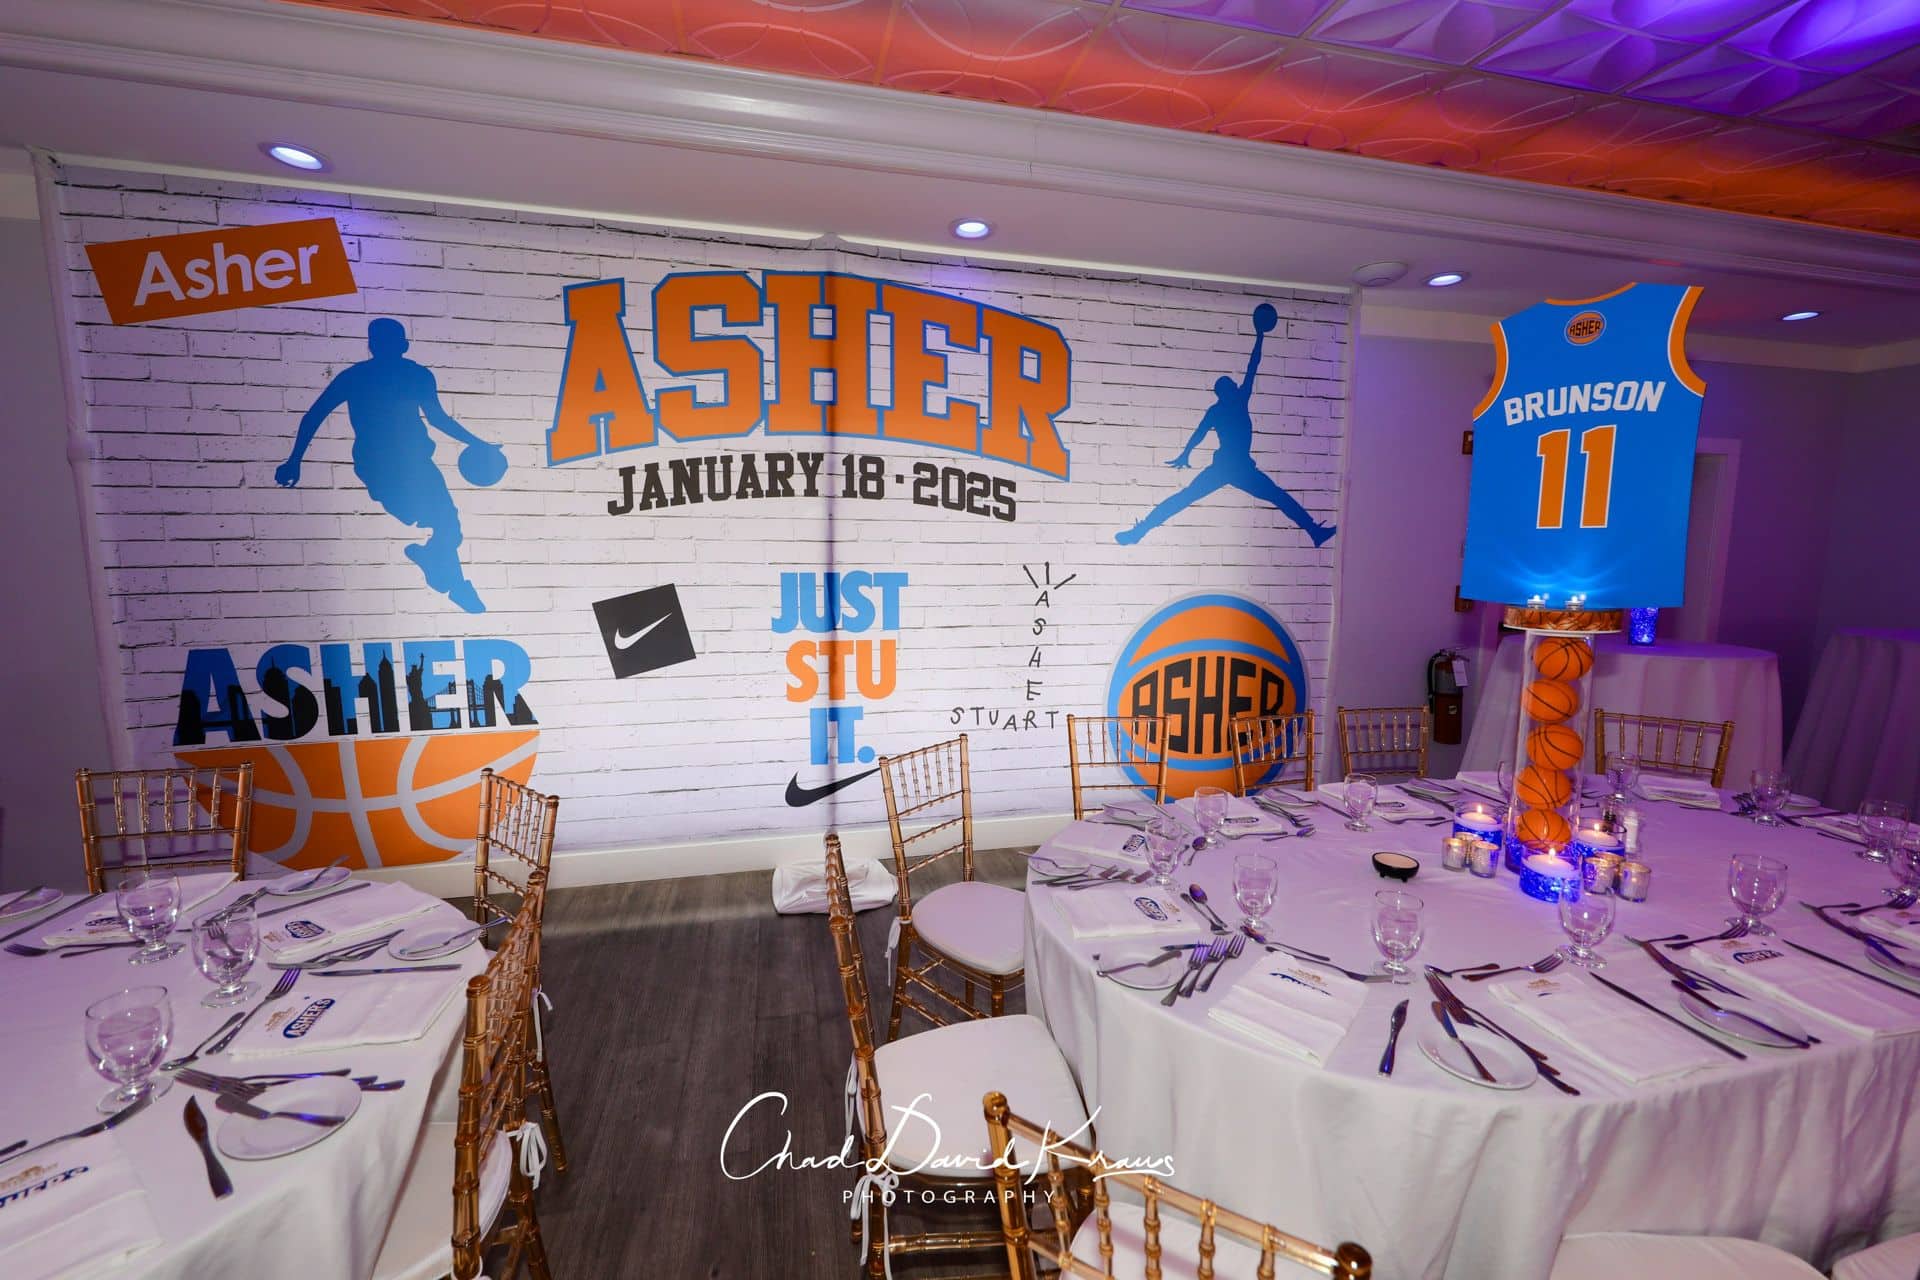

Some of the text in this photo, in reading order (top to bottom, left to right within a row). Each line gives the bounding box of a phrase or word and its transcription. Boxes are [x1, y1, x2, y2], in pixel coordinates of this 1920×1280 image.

[133, 242, 319, 307] Asher
[1569, 319, 1601, 337] ASHER
[546, 270, 1073, 482] ASHER
[1503, 380, 1667, 426] BRUNSON
[606, 452, 1018, 522] JANUARY 18 2025
[1536, 424, 1618, 529] 11
[771, 570, 909, 634] JUST
[172, 638, 540, 746] ASHER
[785, 639, 897, 703] STU
[809, 706, 877, 766] IT.
[950, 707, 1060, 732] STUART
[1131, 656, 1286, 755] ASHER
